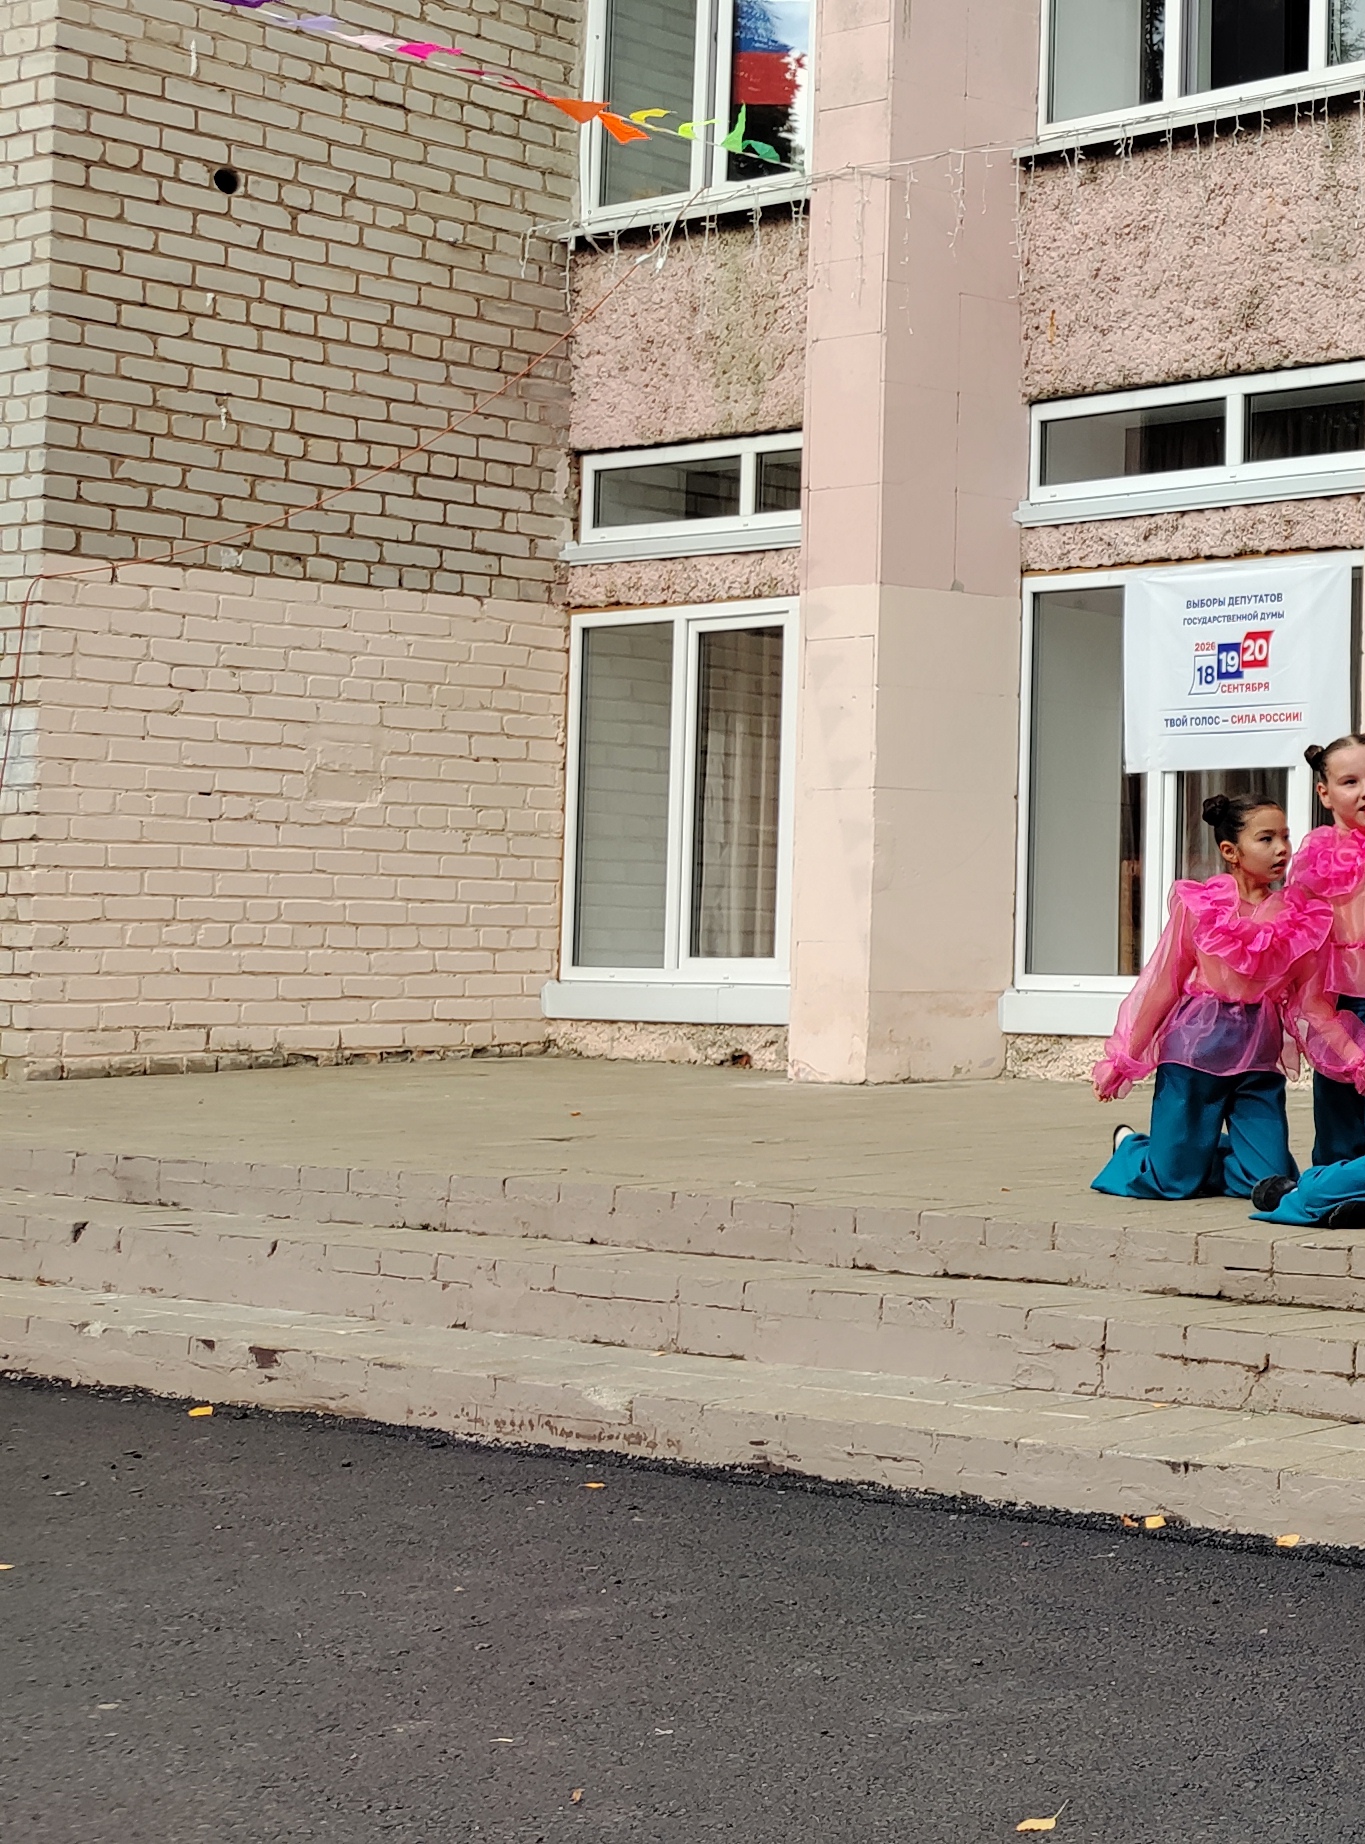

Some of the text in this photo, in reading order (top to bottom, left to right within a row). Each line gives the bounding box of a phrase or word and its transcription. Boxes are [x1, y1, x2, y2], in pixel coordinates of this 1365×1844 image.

[1186, 593, 1283, 610] ВЫБОРЫ ДЕПУТАТОВ
[1183, 610, 1284, 626] ГОСУДАРСТВЕННОЙ ДУМЫ
[1194, 642, 1216, 652] 2026
[1196, 638, 1267, 685] 18 19 20
[1221, 682, 1270, 694] СЕНТЯБРЯ
[1164, 715, 1188, 728] ТВОЙ
[1190, 716, 1220, 726] ГОЛОС
[1231, 714, 1257, 725] СИЛА
[1259, 711, 1302, 722] РОССИИ!
